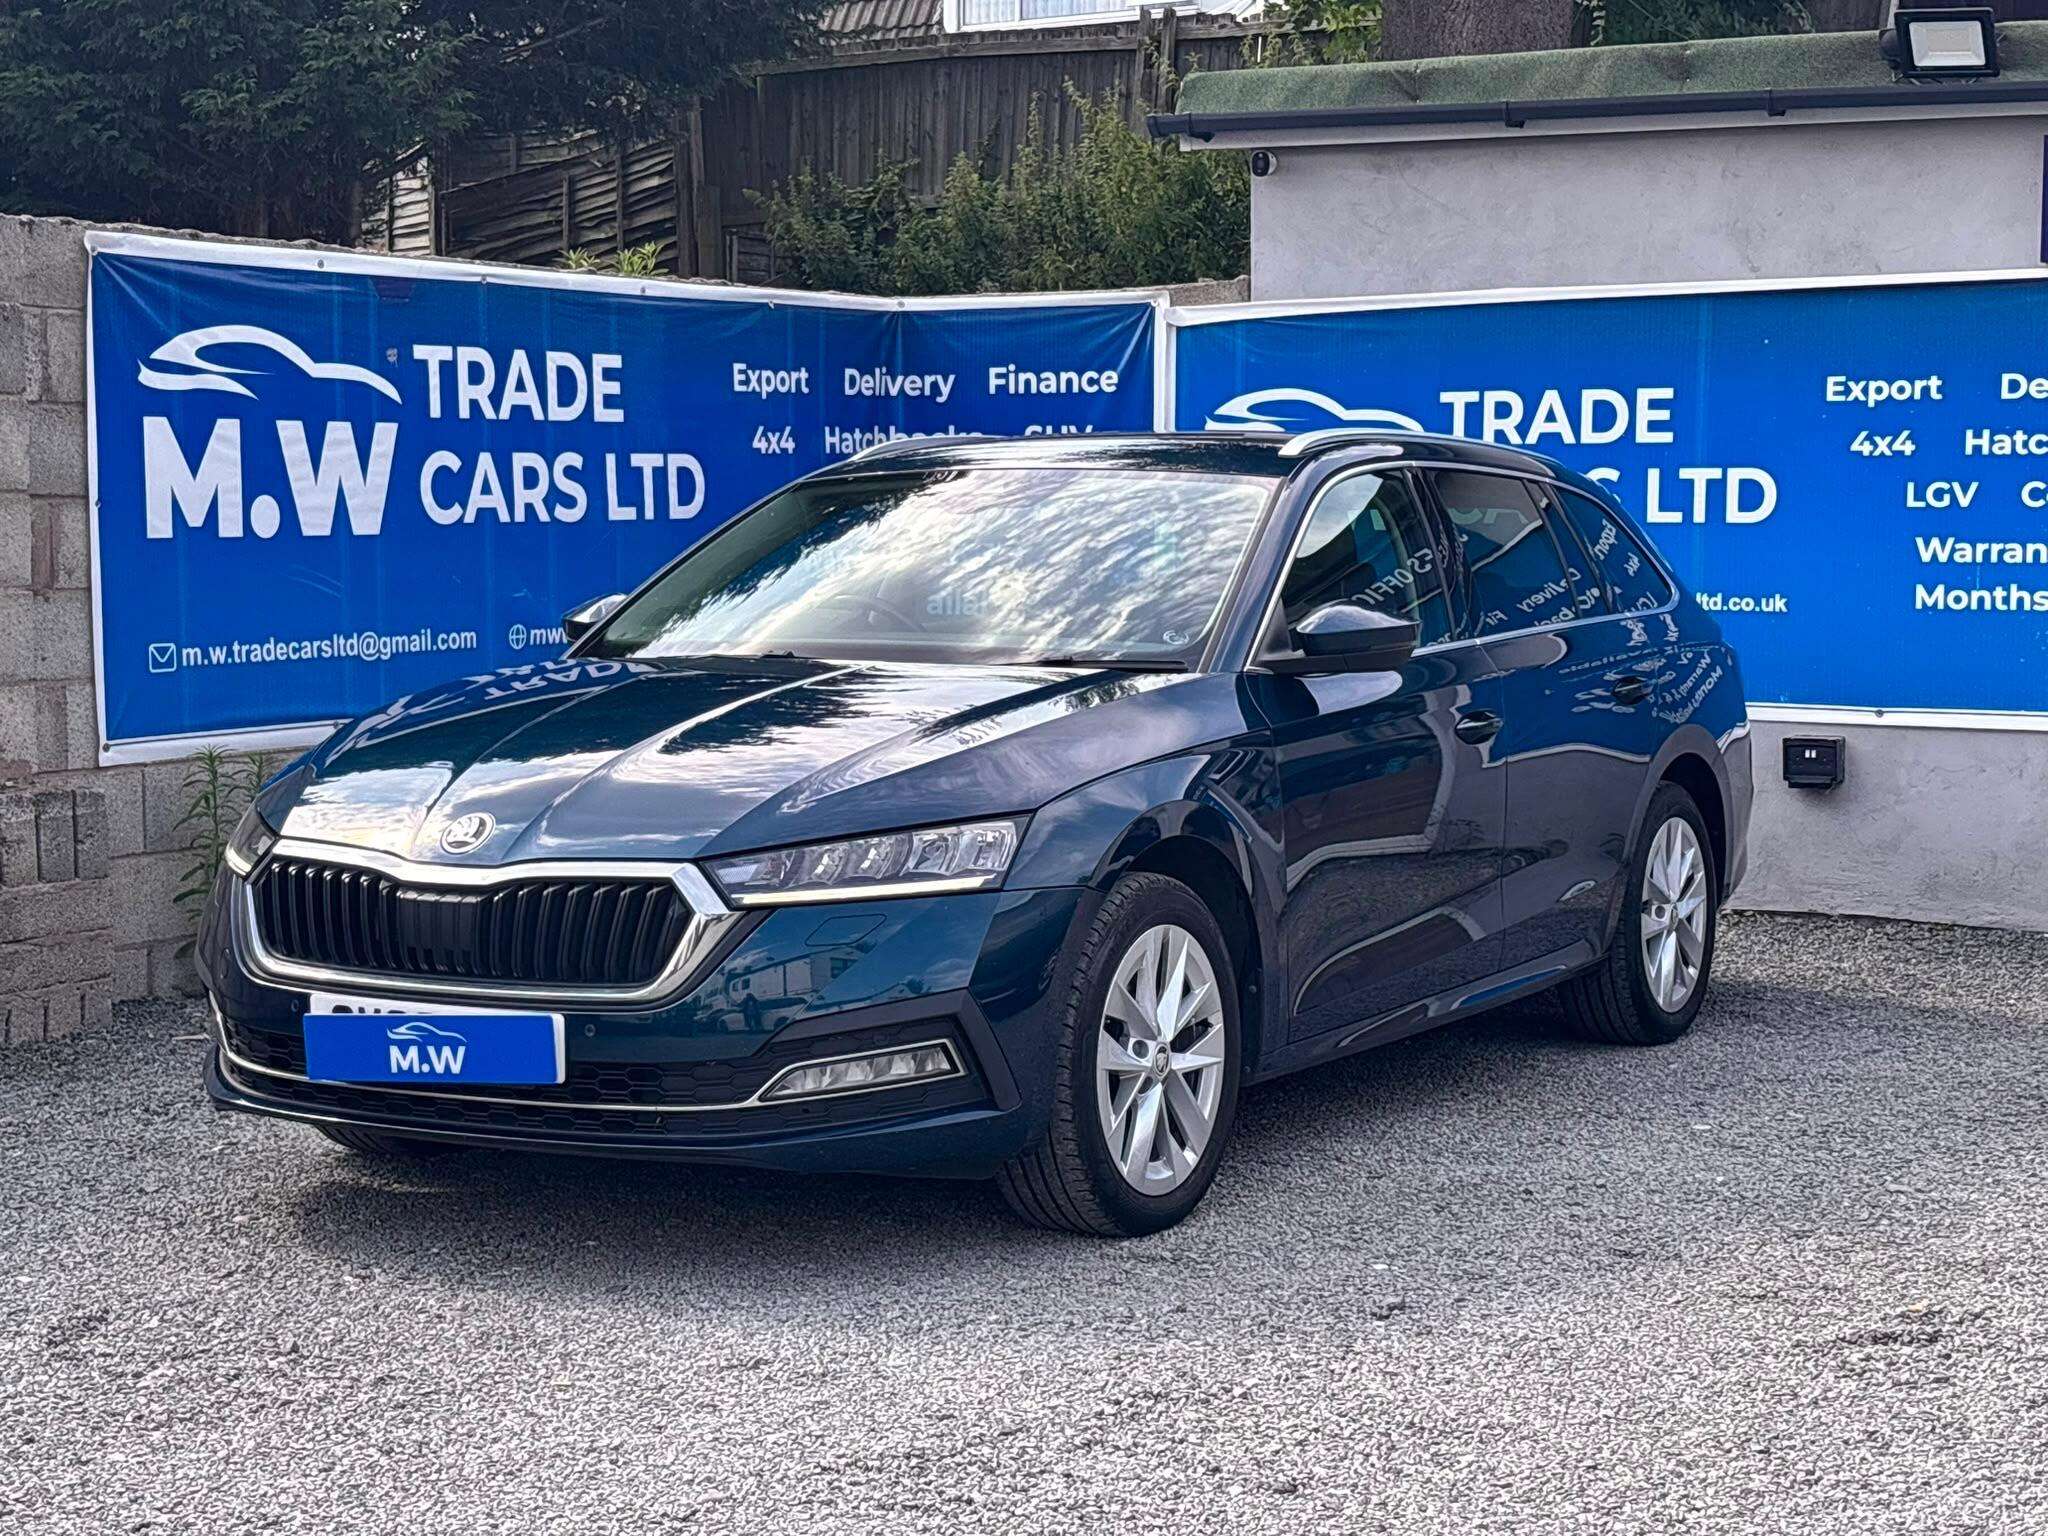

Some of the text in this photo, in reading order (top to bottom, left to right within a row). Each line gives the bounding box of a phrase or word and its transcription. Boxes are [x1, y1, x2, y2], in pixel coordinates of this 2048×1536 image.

[412, 343, 625, 423] TRADE
[732, 362, 1119, 403] Export Delivery Finance
[1826, 372, 2048, 408] Export De
[1439, 387, 1675, 445] TRADE
[752, 425, 796, 454] 4x4
[1849, 428, 2048, 457] 4x4 Hatc
[142, 415, 399, 539] M.W
[420, 450, 706, 525] CARS LTD
[1646, 467, 1778, 524] LTD
[1906, 481, 1979, 508] LGV
[1914, 536, 2048, 564] Warran
[1915, 583, 2048, 612] Months
[182, 628, 477, 666] m.w.tradecarsltd@gmail.com
[389, 1045, 466, 1074] M.W
